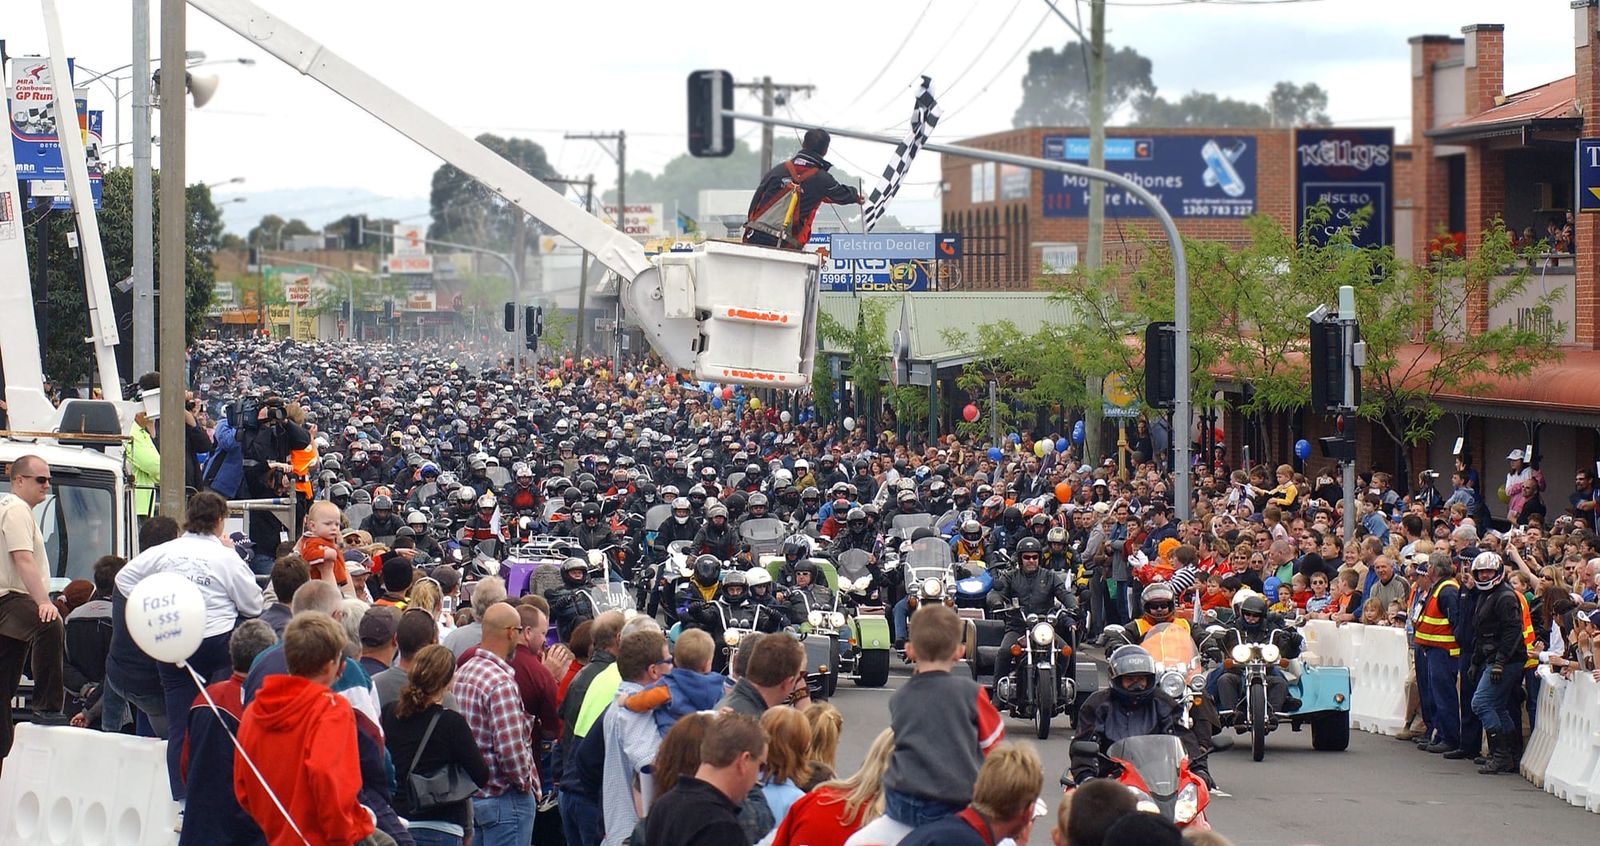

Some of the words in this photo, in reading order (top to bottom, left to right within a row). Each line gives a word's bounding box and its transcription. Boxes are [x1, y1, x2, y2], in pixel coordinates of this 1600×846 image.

[16, 92, 31, 100] GP
[32, 92, 53, 100] Run
[1123, 172, 1183, 188] Phones
[1083, 191, 1120, 205] Hre
[1183, 206, 1209, 215] 1300
[1212, 206, 1230, 215] 783
[1233, 206, 1253, 215] 227
[835, 239, 882, 250] Telstra
[886, 239, 931, 250] Dealer
[822, 275, 846, 283] 5996
[849, 275, 874, 283] 7924
[143, 593, 176, 612] Fast
